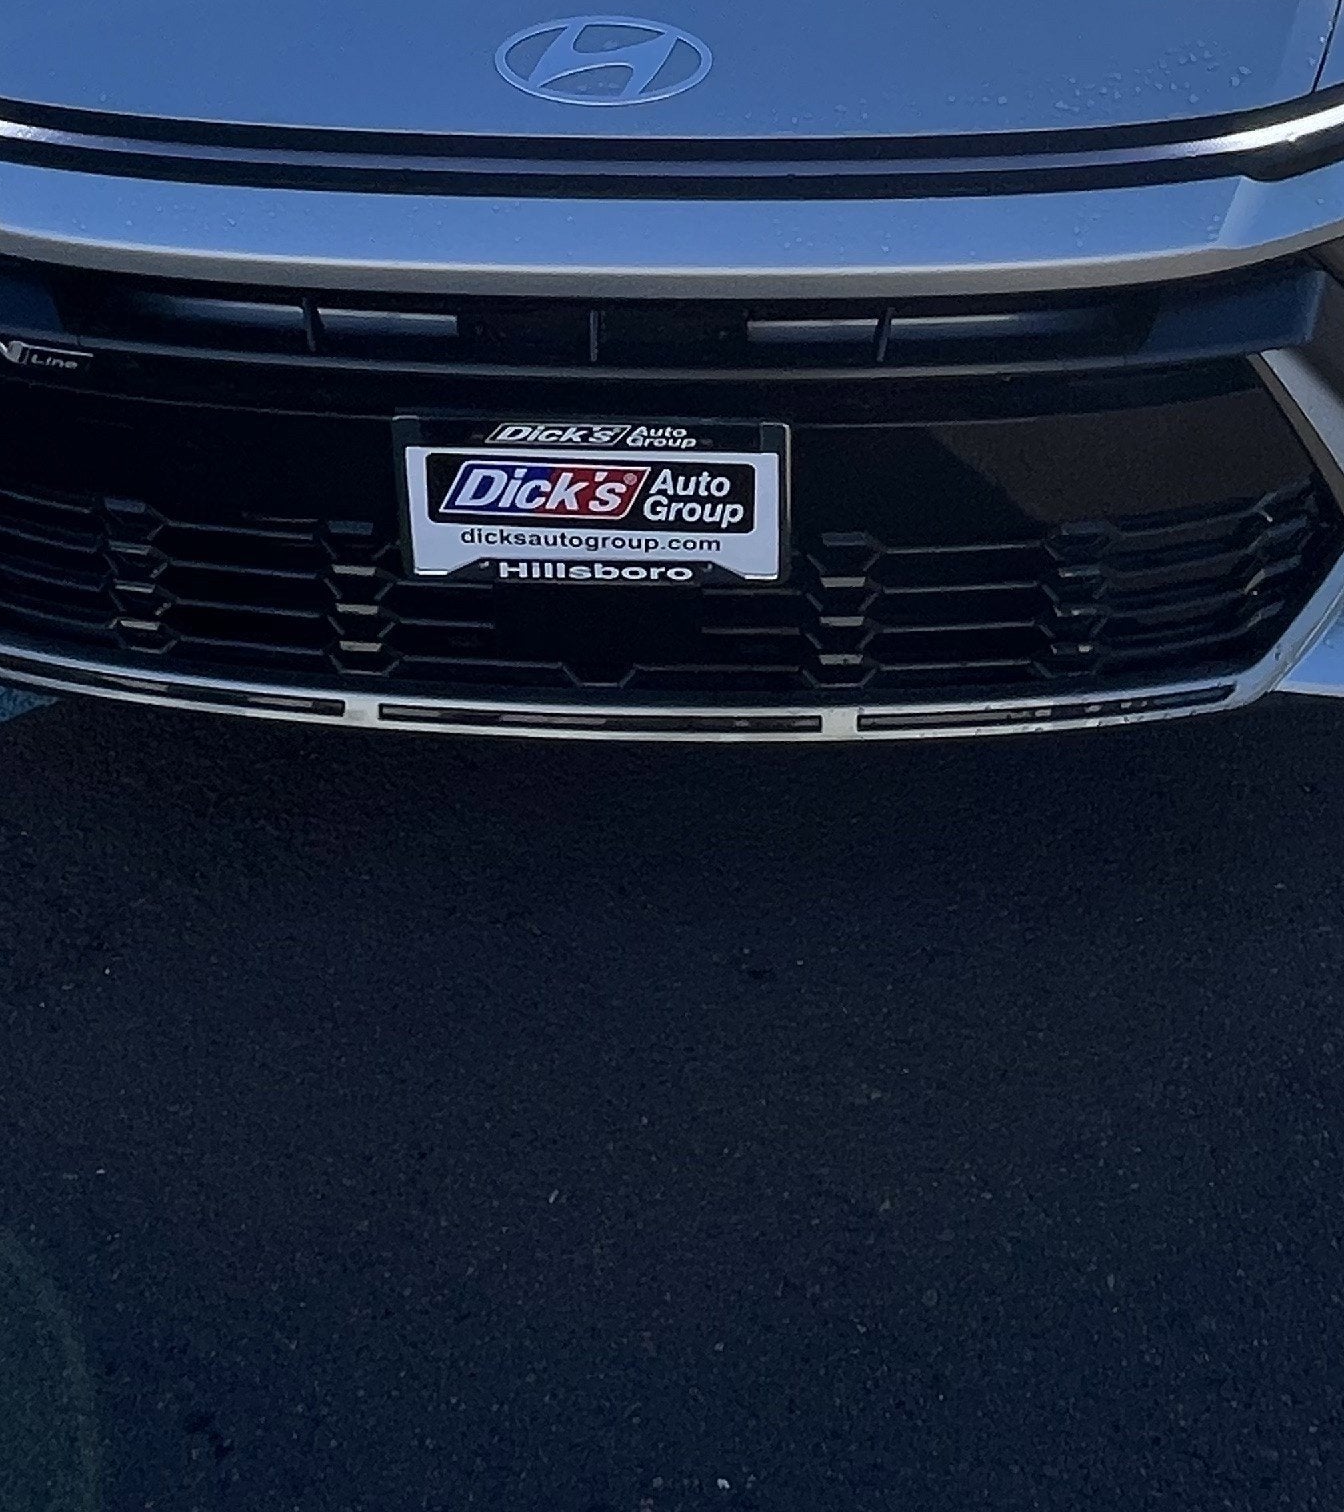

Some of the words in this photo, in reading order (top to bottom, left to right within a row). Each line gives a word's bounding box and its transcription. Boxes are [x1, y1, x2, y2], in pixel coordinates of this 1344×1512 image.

[495, 424, 623, 445] Dick's
[626, 435, 697, 449] Group
[630, 425, 688, 438] Auto
[454, 468, 628, 513] Dick's
[650, 469, 731, 498] Auto
[642, 495, 745, 529] Group
[460, 528, 721, 553] dicksautogroup.com
[499, 562, 693, 581] Hillsboro
